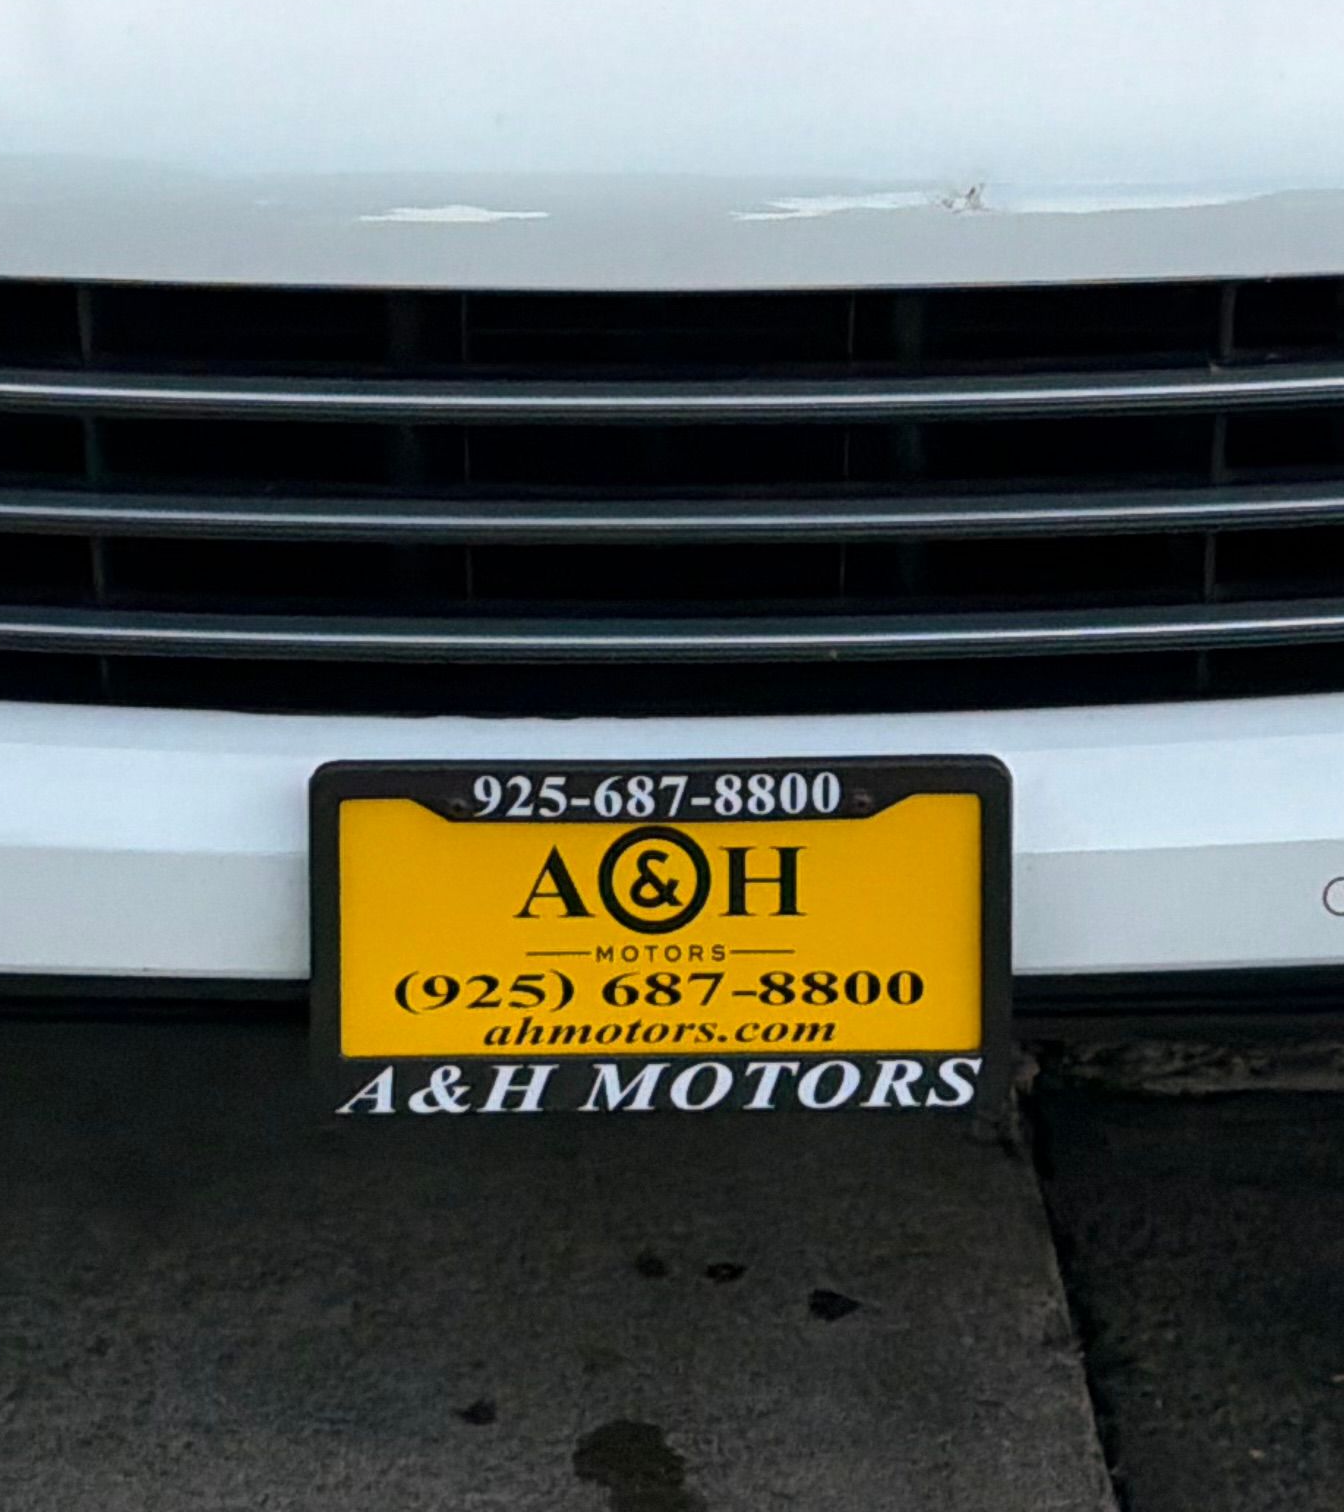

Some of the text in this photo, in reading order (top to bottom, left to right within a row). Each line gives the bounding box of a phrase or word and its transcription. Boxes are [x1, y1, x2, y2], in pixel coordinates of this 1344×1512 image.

[473, 772, 840, 817] 925-687-8800
[595, 944, 727, 963] MOTORS
[394, 970, 924, 1014] (925) 687-8800
[484, 1018, 836, 1045] ahmotors.com
[336, 1058, 981, 1113] A&H MOTORS
